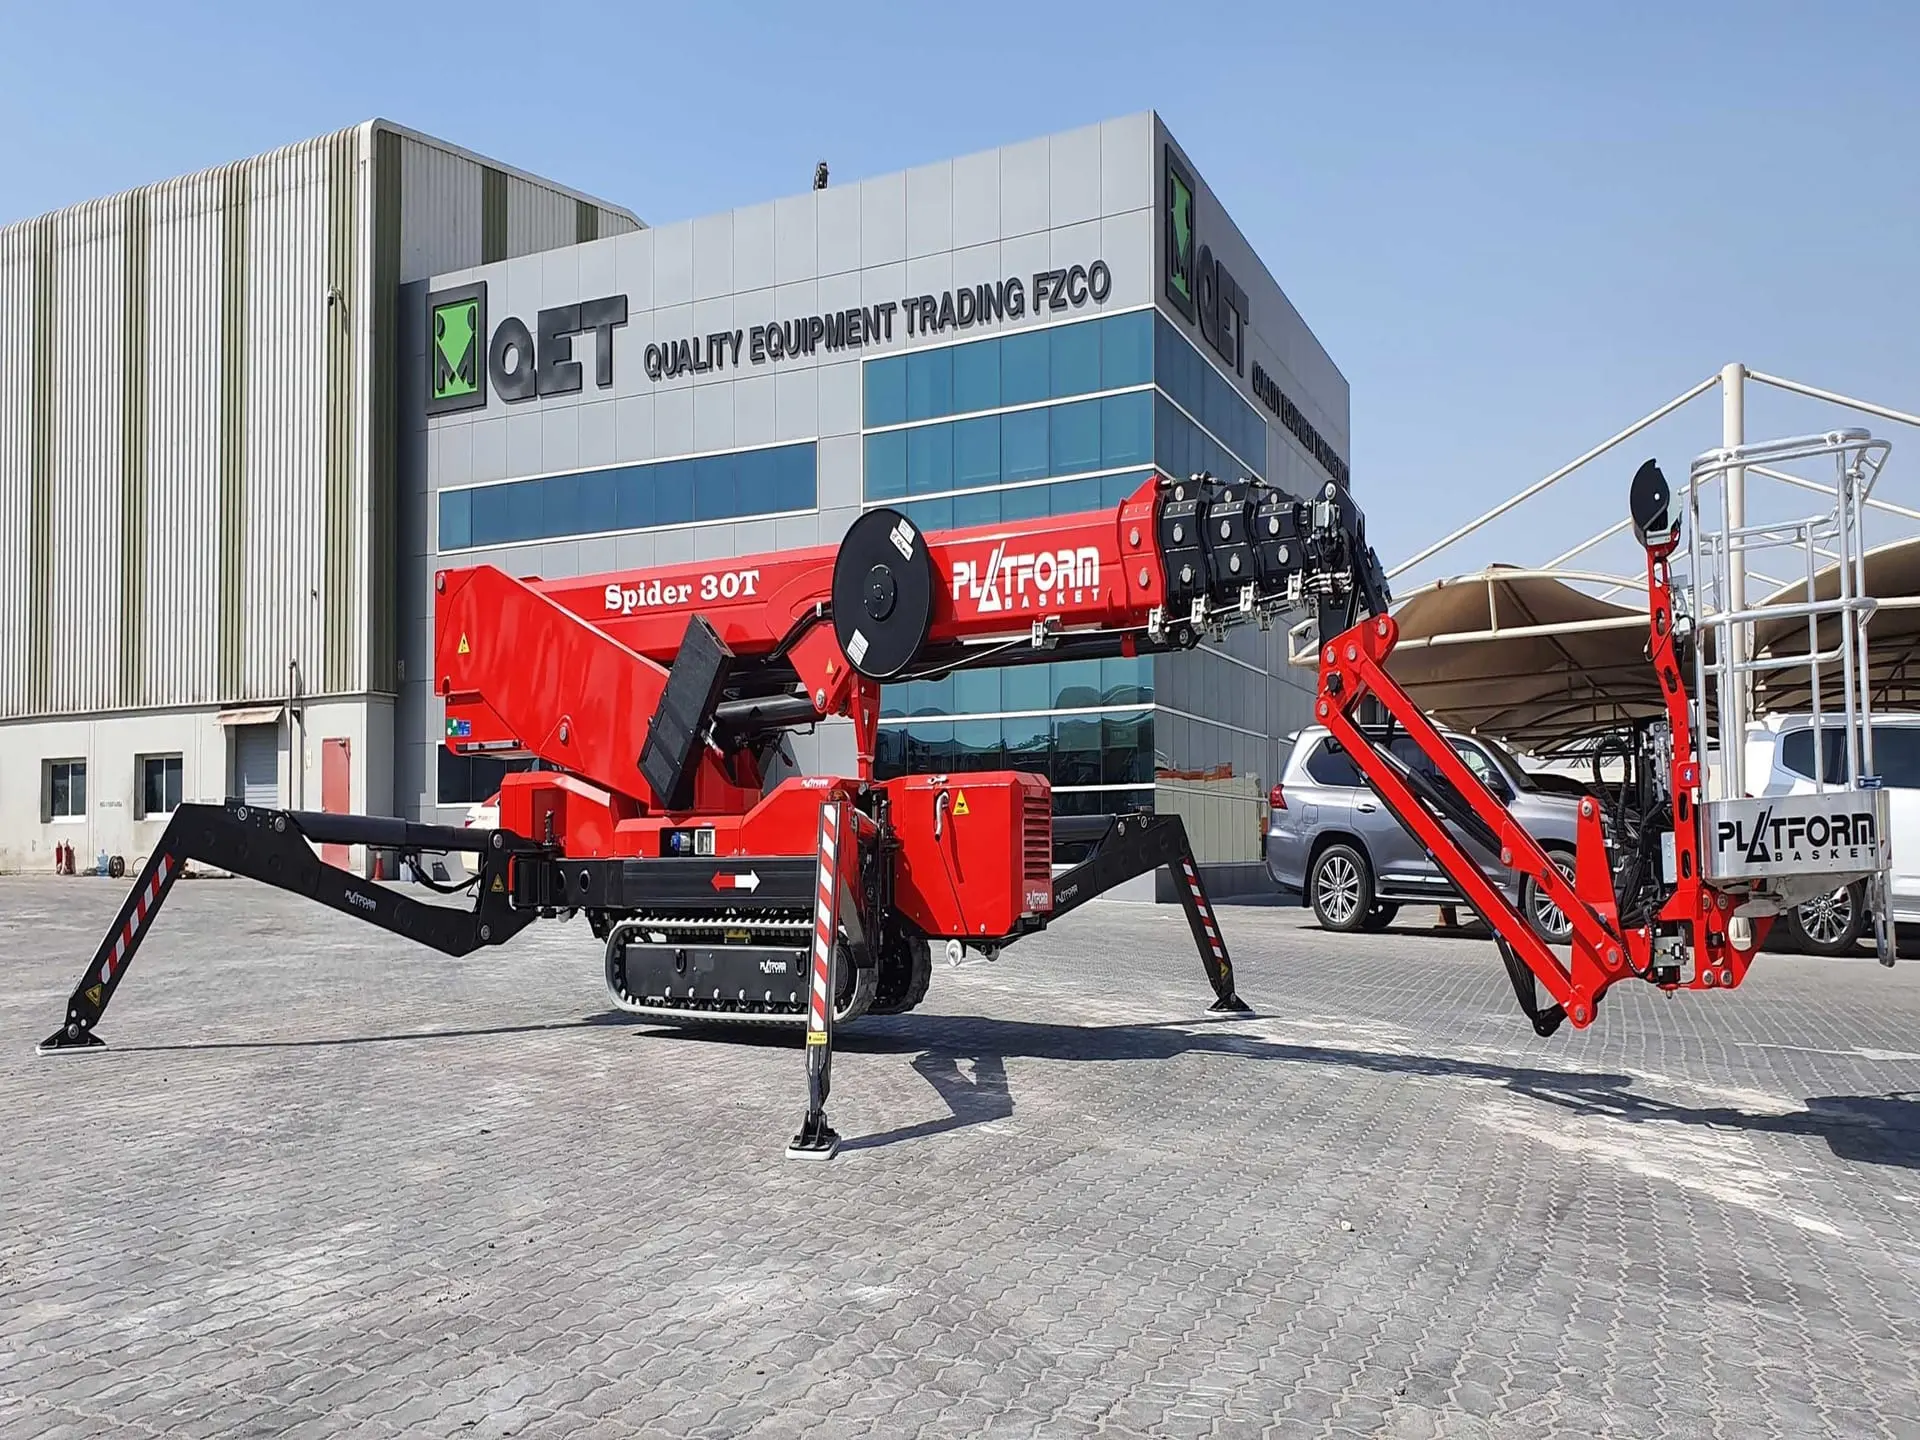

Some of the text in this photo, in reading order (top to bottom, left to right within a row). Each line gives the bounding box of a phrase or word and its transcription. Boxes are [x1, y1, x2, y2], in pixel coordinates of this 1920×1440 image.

[643, 259, 1112, 382] QUALITY EQUIPMENT TRADING FZCO
[1196, 244, 1250, 378] QET
[488, 294, 628, 404] QET
[604, 570, 760, 614] Spider 30T
[953, 541, 1100, 612] PLATFORM
[1004, 588, 1100, 610] BASKET
[1718, 805, 1875, 863] PLATFORM
[1774, 847, 1876, 862] BASKET
